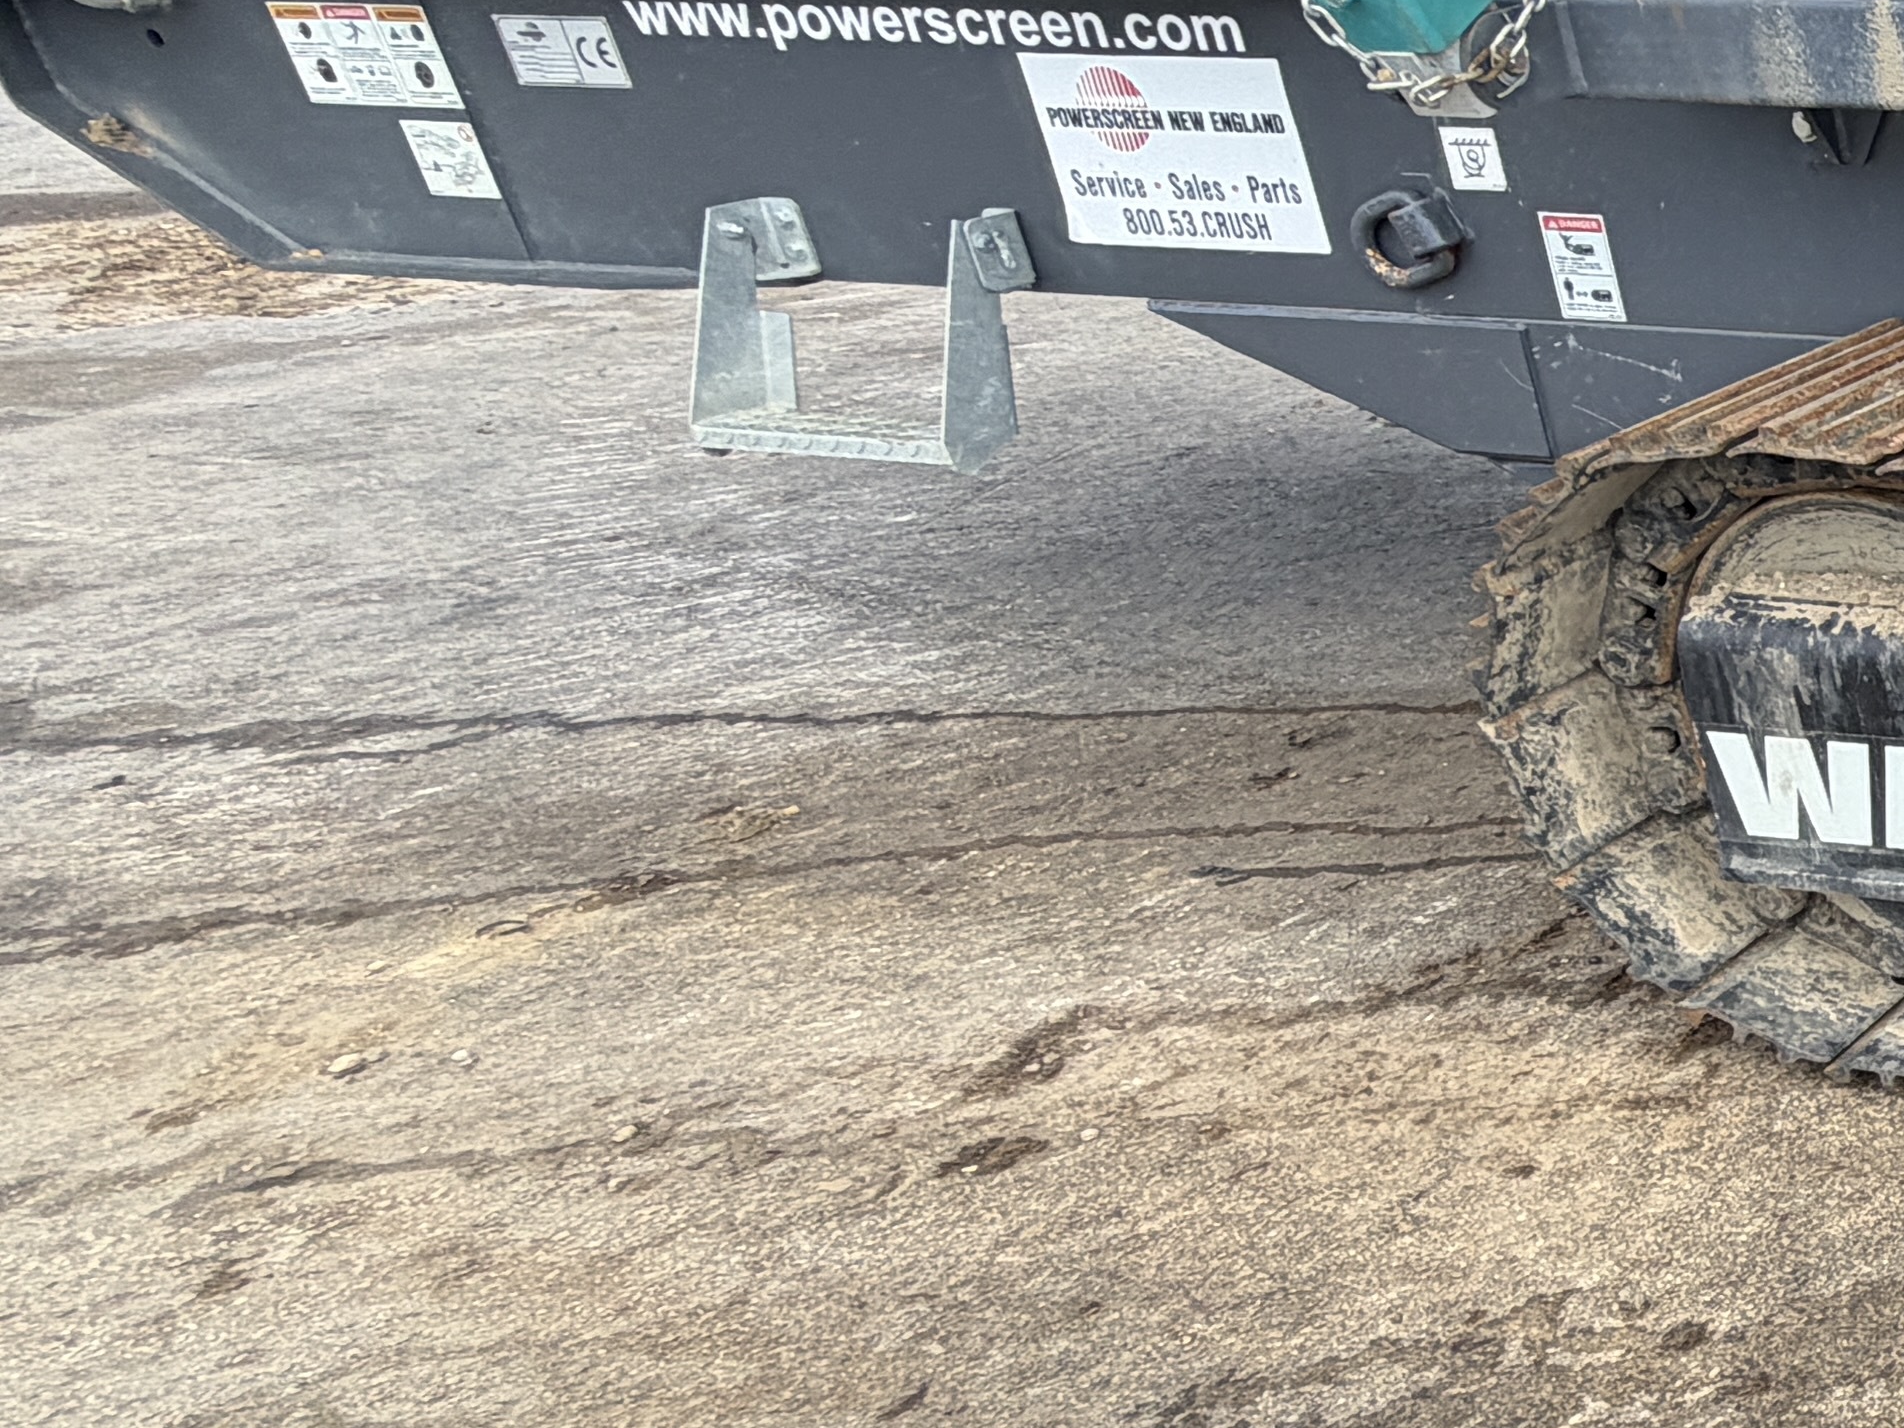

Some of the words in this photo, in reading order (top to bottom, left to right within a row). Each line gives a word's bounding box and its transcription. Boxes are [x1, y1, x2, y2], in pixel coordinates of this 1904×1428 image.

[623, 0, 1247, 53] www.powerscreen.com
[576, 36, 618, 69] CE
[1046, 107, 1164, 131] POWERSCREEN
[1168, 111, 1205, 132] NEW
[1212, 112, 1286, 134] ENGLAND
[1070, 170, 1147, 199] Service
[1168, 173, 1225, 202] Sales
[1246, 175, 1302, 204] Parts
[1122, 208, 1272, 240] 800.53.CRUSH
